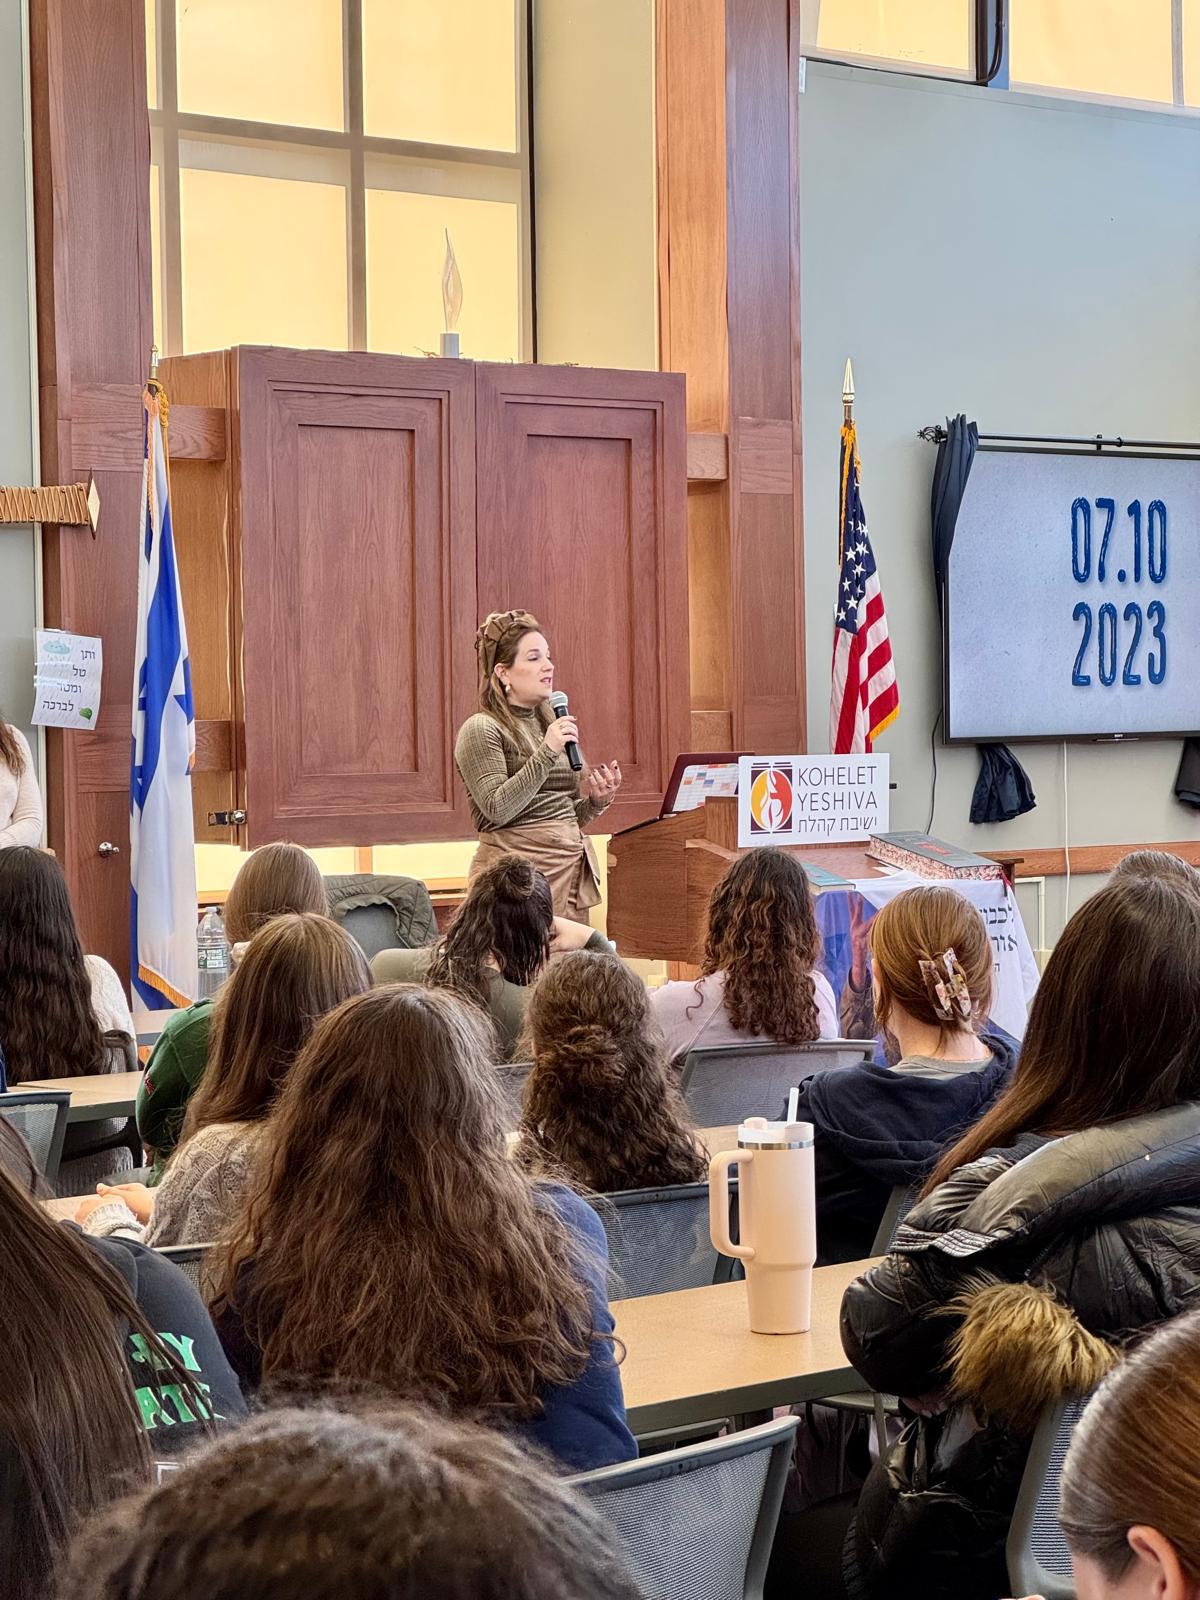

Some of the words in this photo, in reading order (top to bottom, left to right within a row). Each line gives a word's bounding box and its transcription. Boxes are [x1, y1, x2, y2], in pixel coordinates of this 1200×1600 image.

[1071, 496, 1167, 583] 07.10
[1072, 600, 1167, 686] 2023
[81, 649, 96, 660] ותן
[72, 664, 87, 678] טל
[42, 700, 75, 712] לברכה
[798, 765, 877, 787] KOHELET
[797, 790, 878, 812] YESHIVA
[798, 815, 836, 837] קהלת
[840, 816, 877, 831] ישיבת
